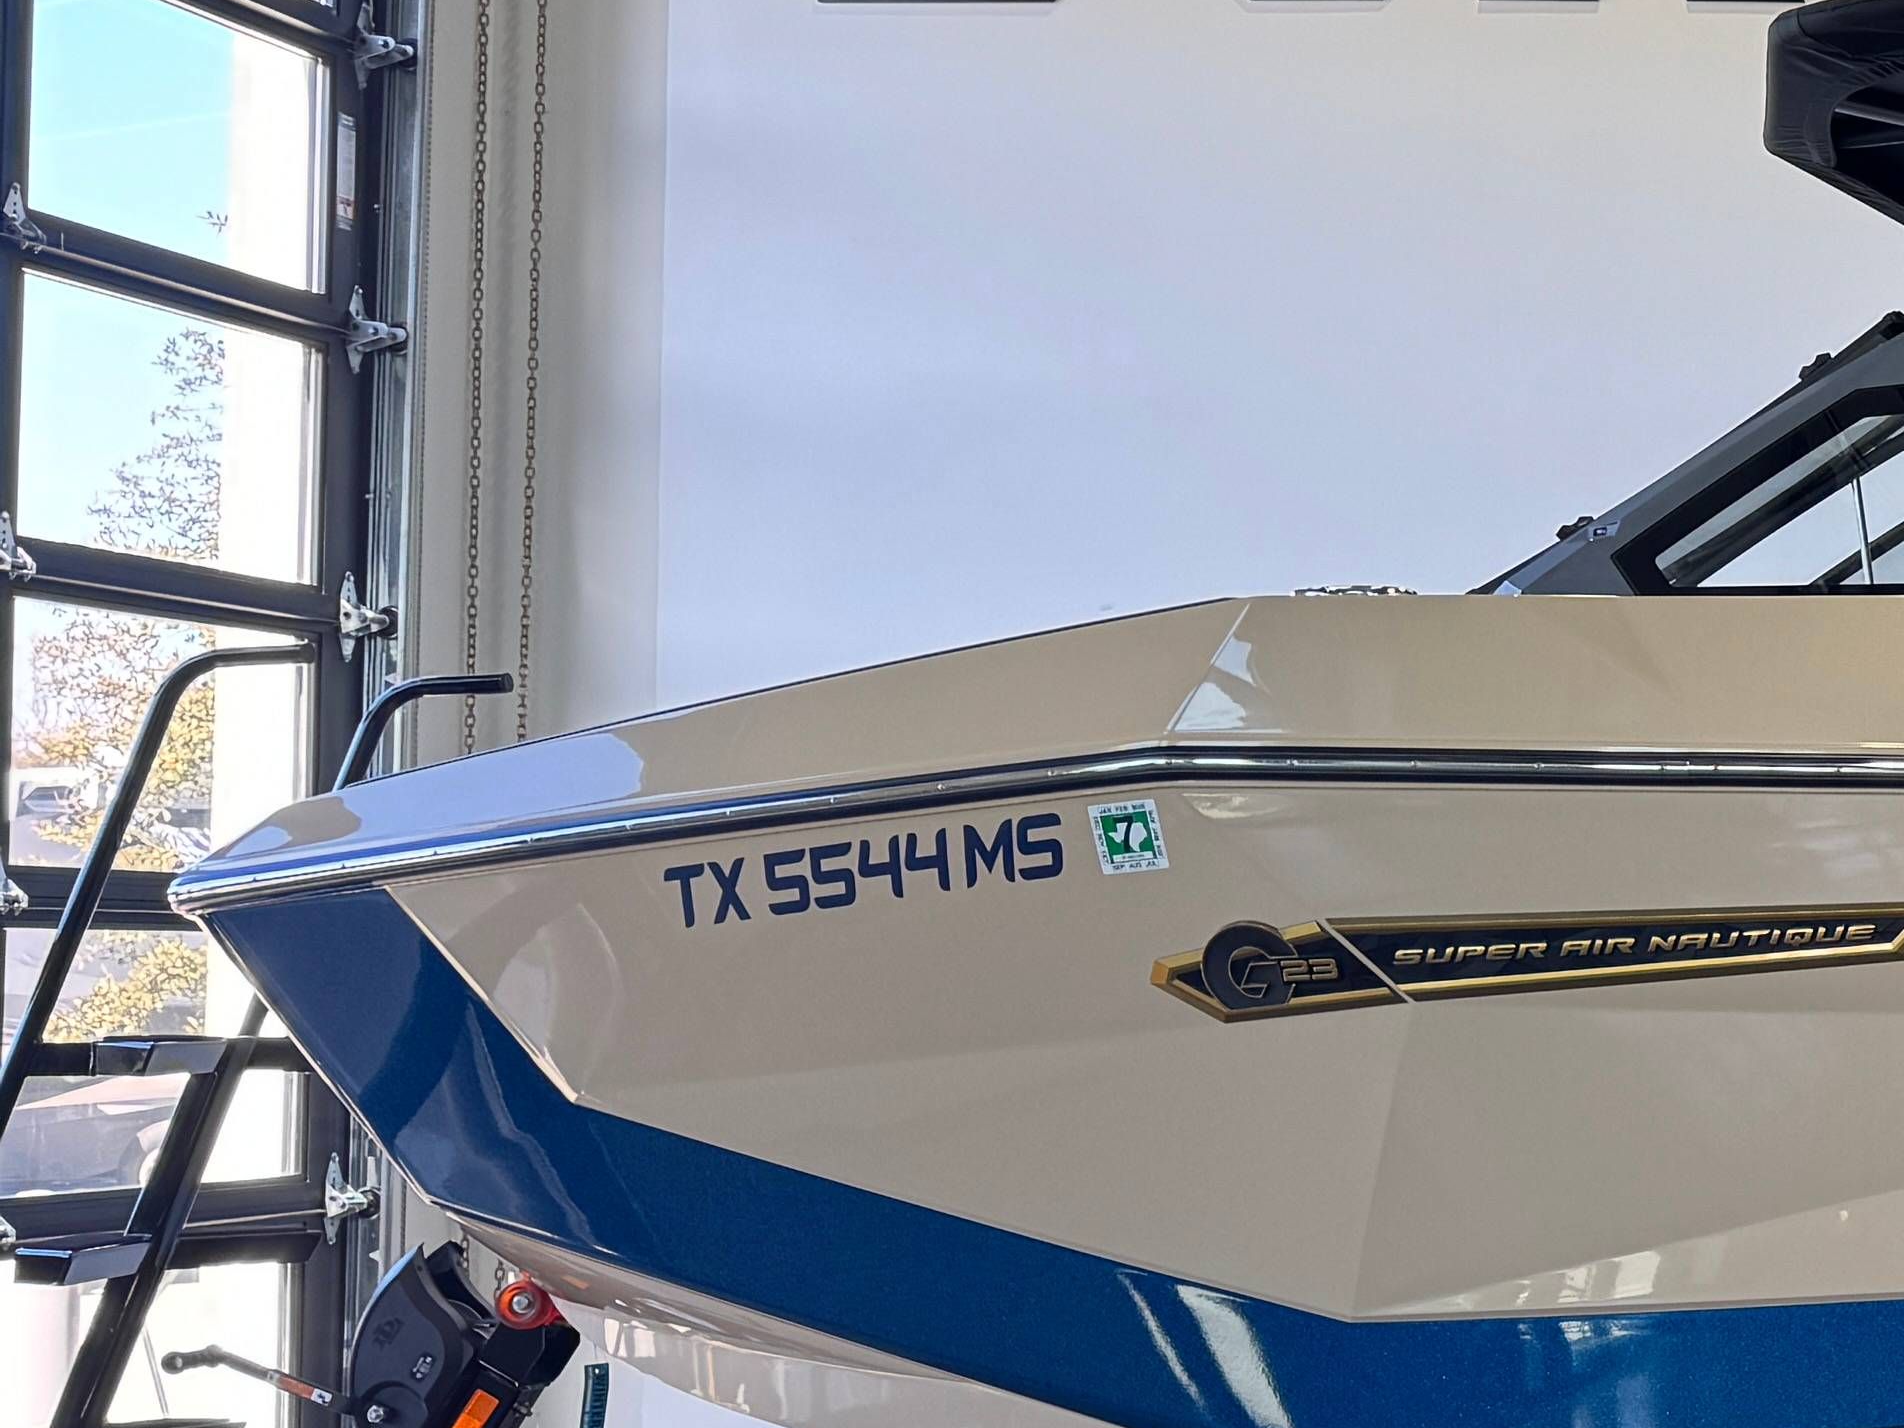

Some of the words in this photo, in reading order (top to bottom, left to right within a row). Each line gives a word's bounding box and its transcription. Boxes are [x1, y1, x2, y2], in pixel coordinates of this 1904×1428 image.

[664, 857, 752, 928] TX
[763, 827, 951, 916] 5544
[963, 812, 1063, 889] MS
[1393, 939, 1548, 969] SUPER
[1559, 934, 1635, 958] AIR
[1648, 922, 1877, 954] NAUTIQUE
